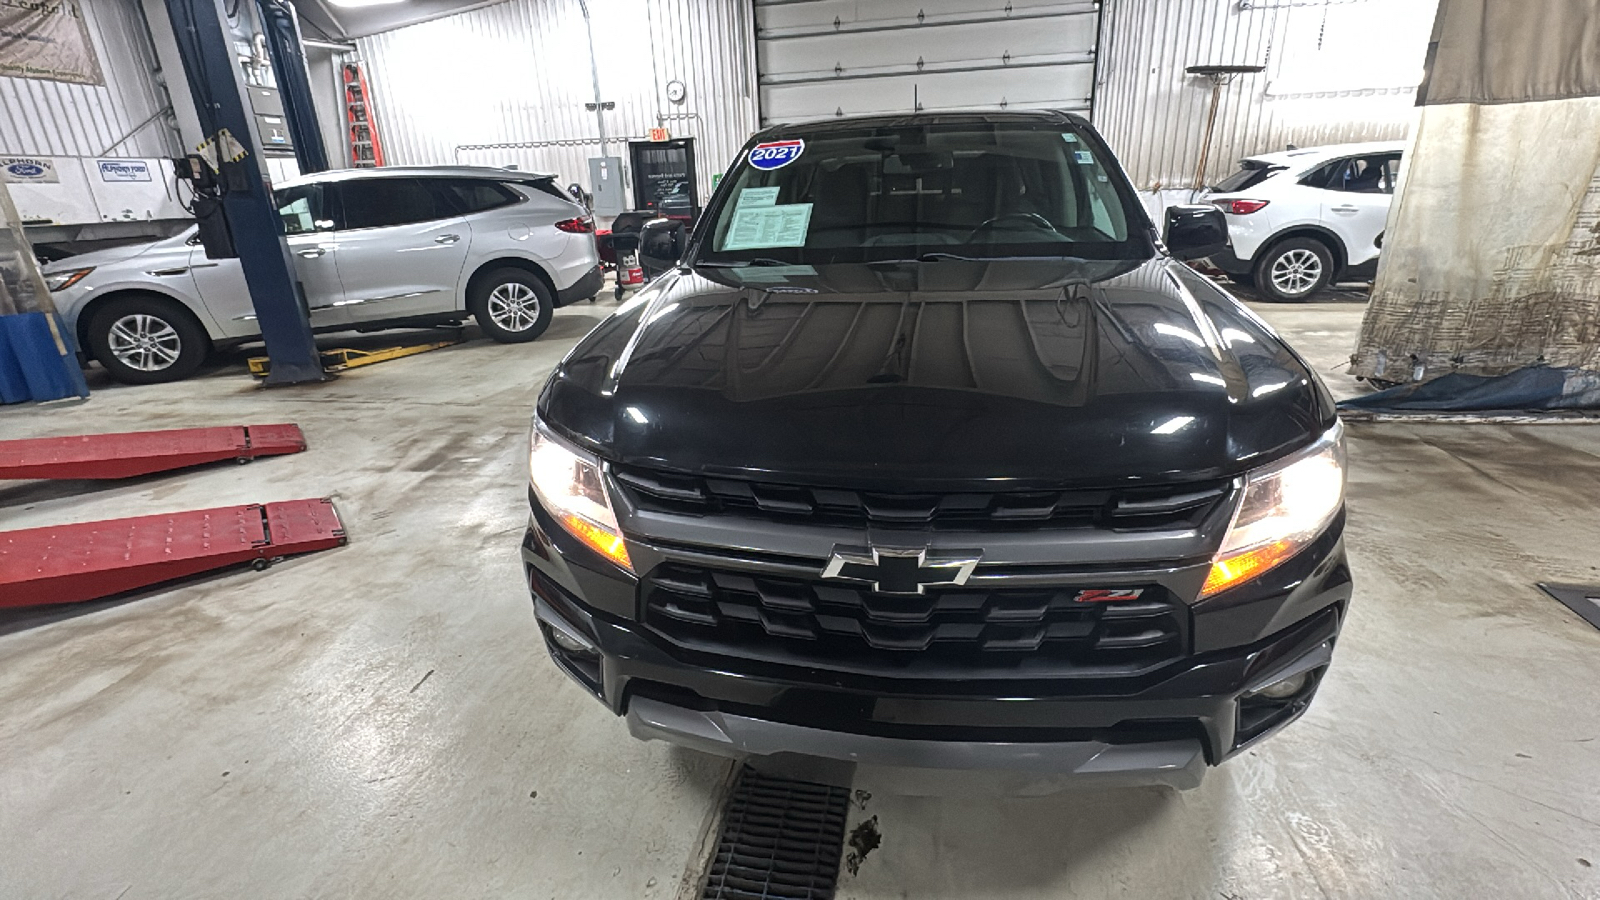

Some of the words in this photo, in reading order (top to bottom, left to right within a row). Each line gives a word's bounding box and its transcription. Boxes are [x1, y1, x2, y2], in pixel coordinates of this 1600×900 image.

[652, 129, 665, 140] EXIT
[751, 146, 798, 161] 2021
[15, 165, 37, 174] Ford
